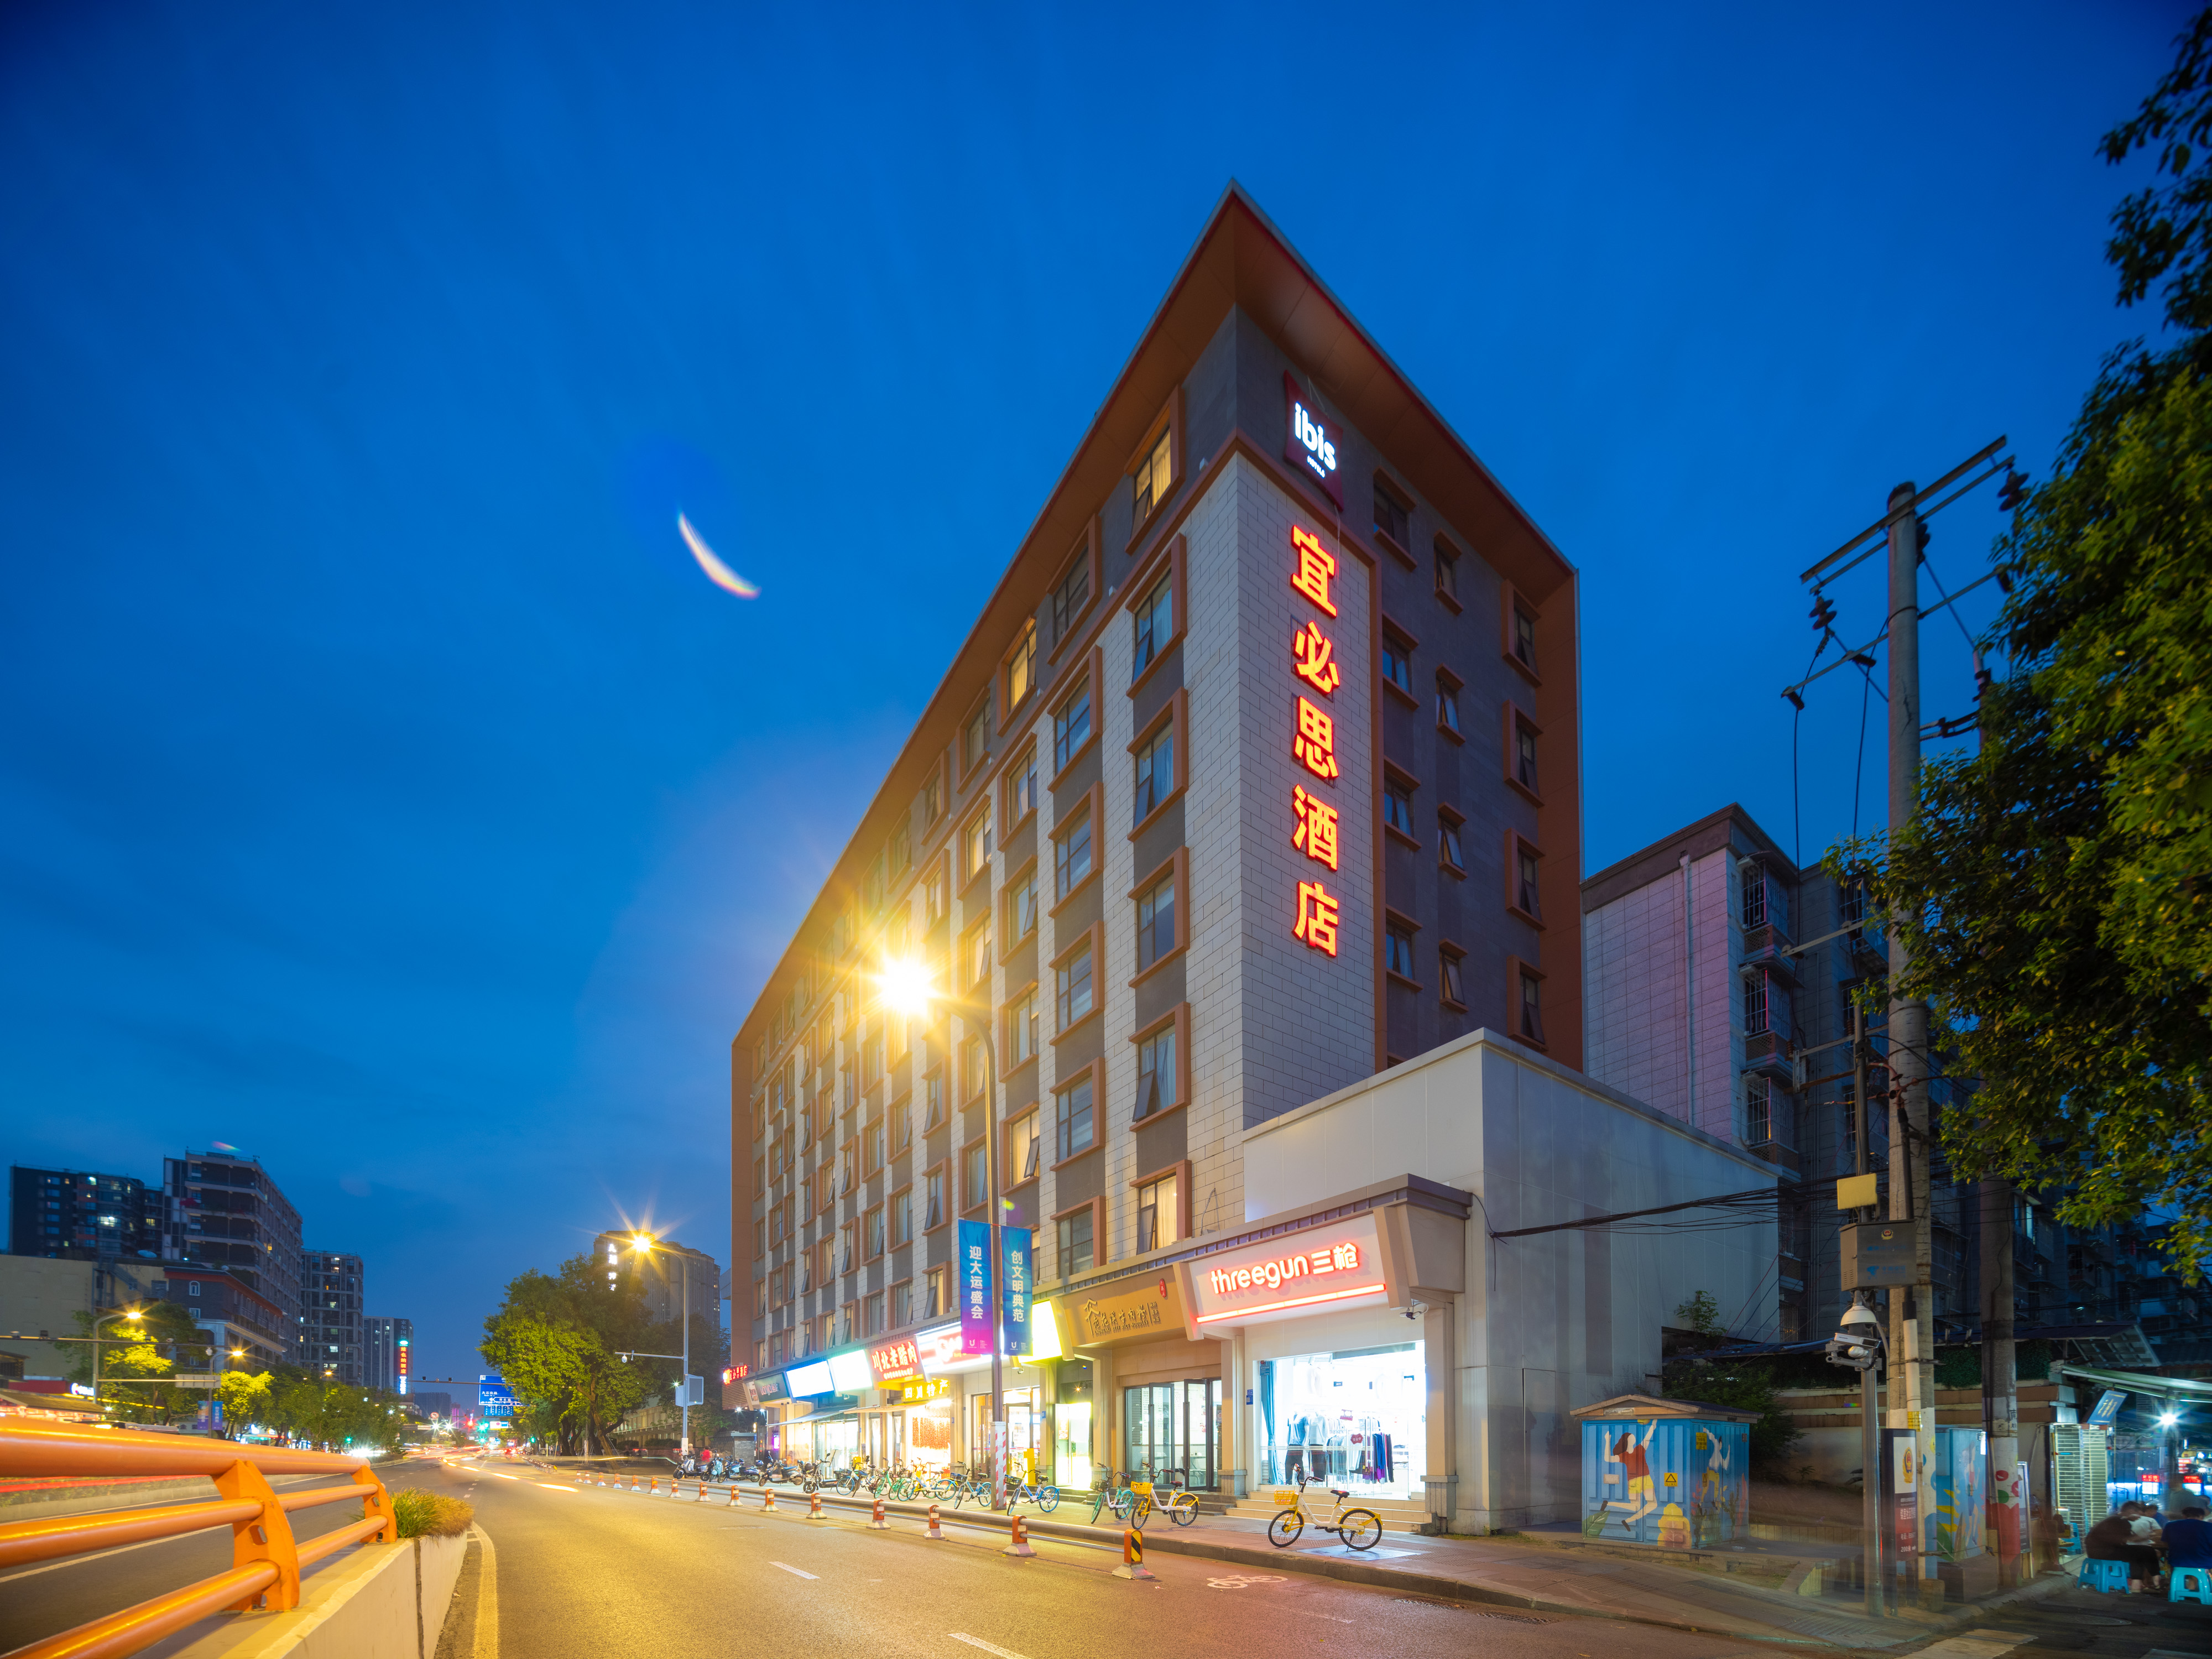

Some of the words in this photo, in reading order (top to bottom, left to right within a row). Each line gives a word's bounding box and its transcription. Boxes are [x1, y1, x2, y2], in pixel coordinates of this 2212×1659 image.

[1295, 401, 1336, 471] ibis
[1291, 525, 1340, 957] 宜必思酒店
[969, 1245, 983, 1319] 迎大运盛会
[1011, 1250, 1024, 1322] 创文明典范
[1211, 1255, 1310, 1295] threegun
[1311, 1243, 1359, 1275] 三枪
[1093, 1304, 1146, 1328] 老花溪牛肉粉
[905, 1379, 949, 1399] 四川特产
